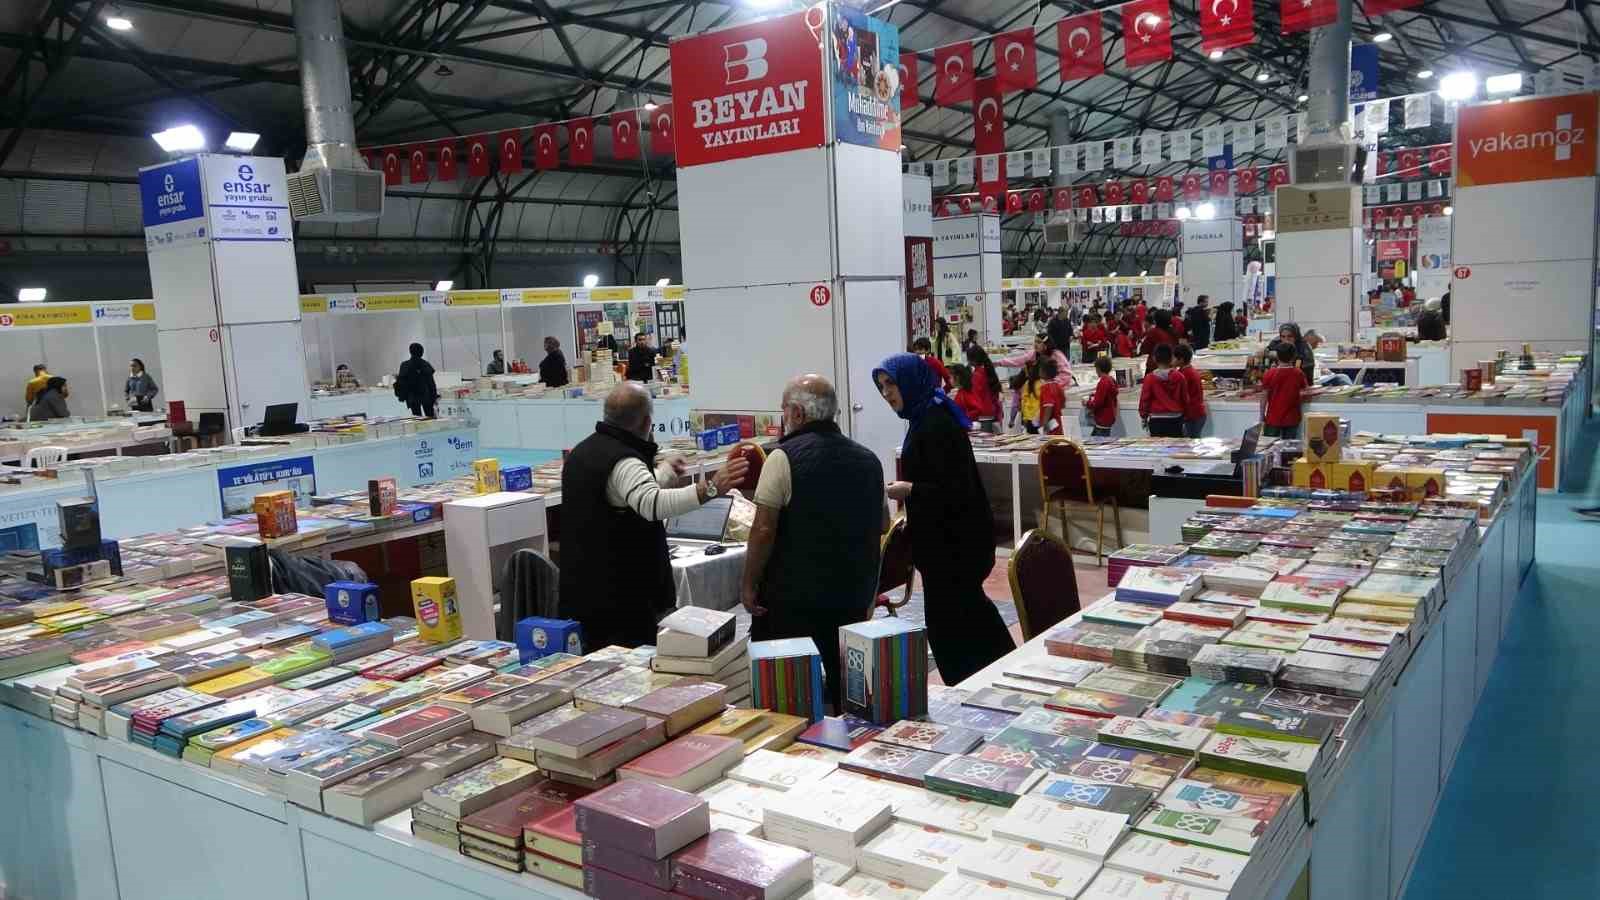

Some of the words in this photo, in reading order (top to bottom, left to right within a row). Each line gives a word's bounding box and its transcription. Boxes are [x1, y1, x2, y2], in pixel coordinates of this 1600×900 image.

[692, 80, 808, 129] BEYAN
[702, 118, 800, 149] YAYINLARI
[1470, 128, 1585, 158] yakamoz
[223, 182, 271, 195] ensar
[158, 191, 185, 207] ensar
[814, 287, 826, 304] 66
[454, 440, 473, 450] dem
